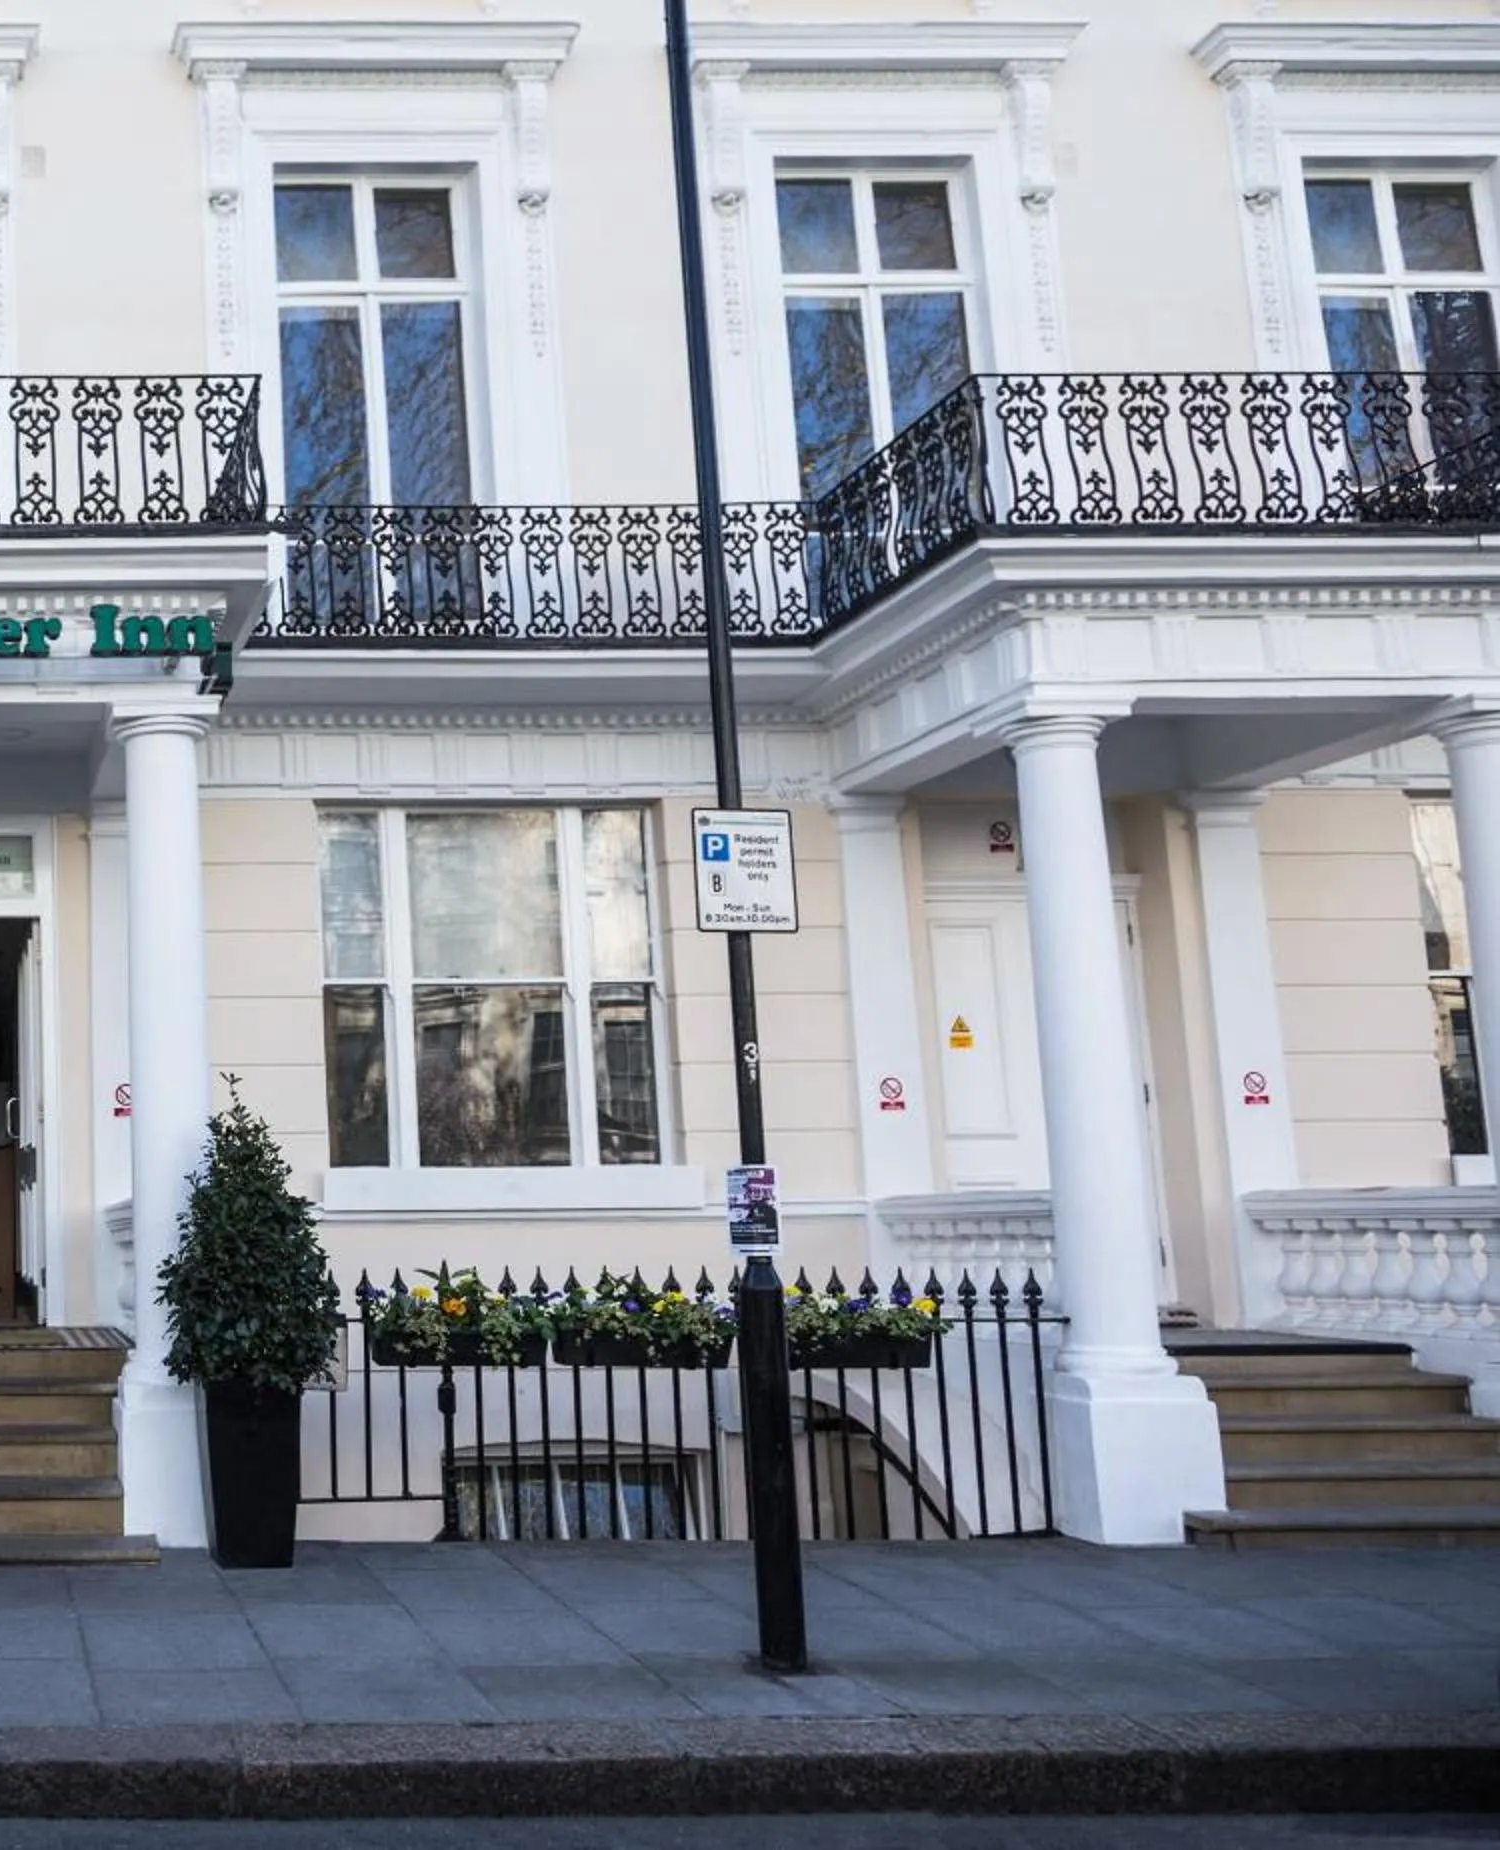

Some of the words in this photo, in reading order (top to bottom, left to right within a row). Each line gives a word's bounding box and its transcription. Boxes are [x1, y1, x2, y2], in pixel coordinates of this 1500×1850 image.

[89, 603, 215, 658] Inn
[733, 833, 779, 845] Resident
[707, 835, 725, 858] P
[739, 848, 774, 857] permit
[738, 859, 777, 869] holders
[747, 871, 769, 881] only
[711, 873, 723, 893] B
[723, 902, 745, 912] Mon
[752, 902, 771, 912] Sun
[743, 1041, 758, 1063] 3
